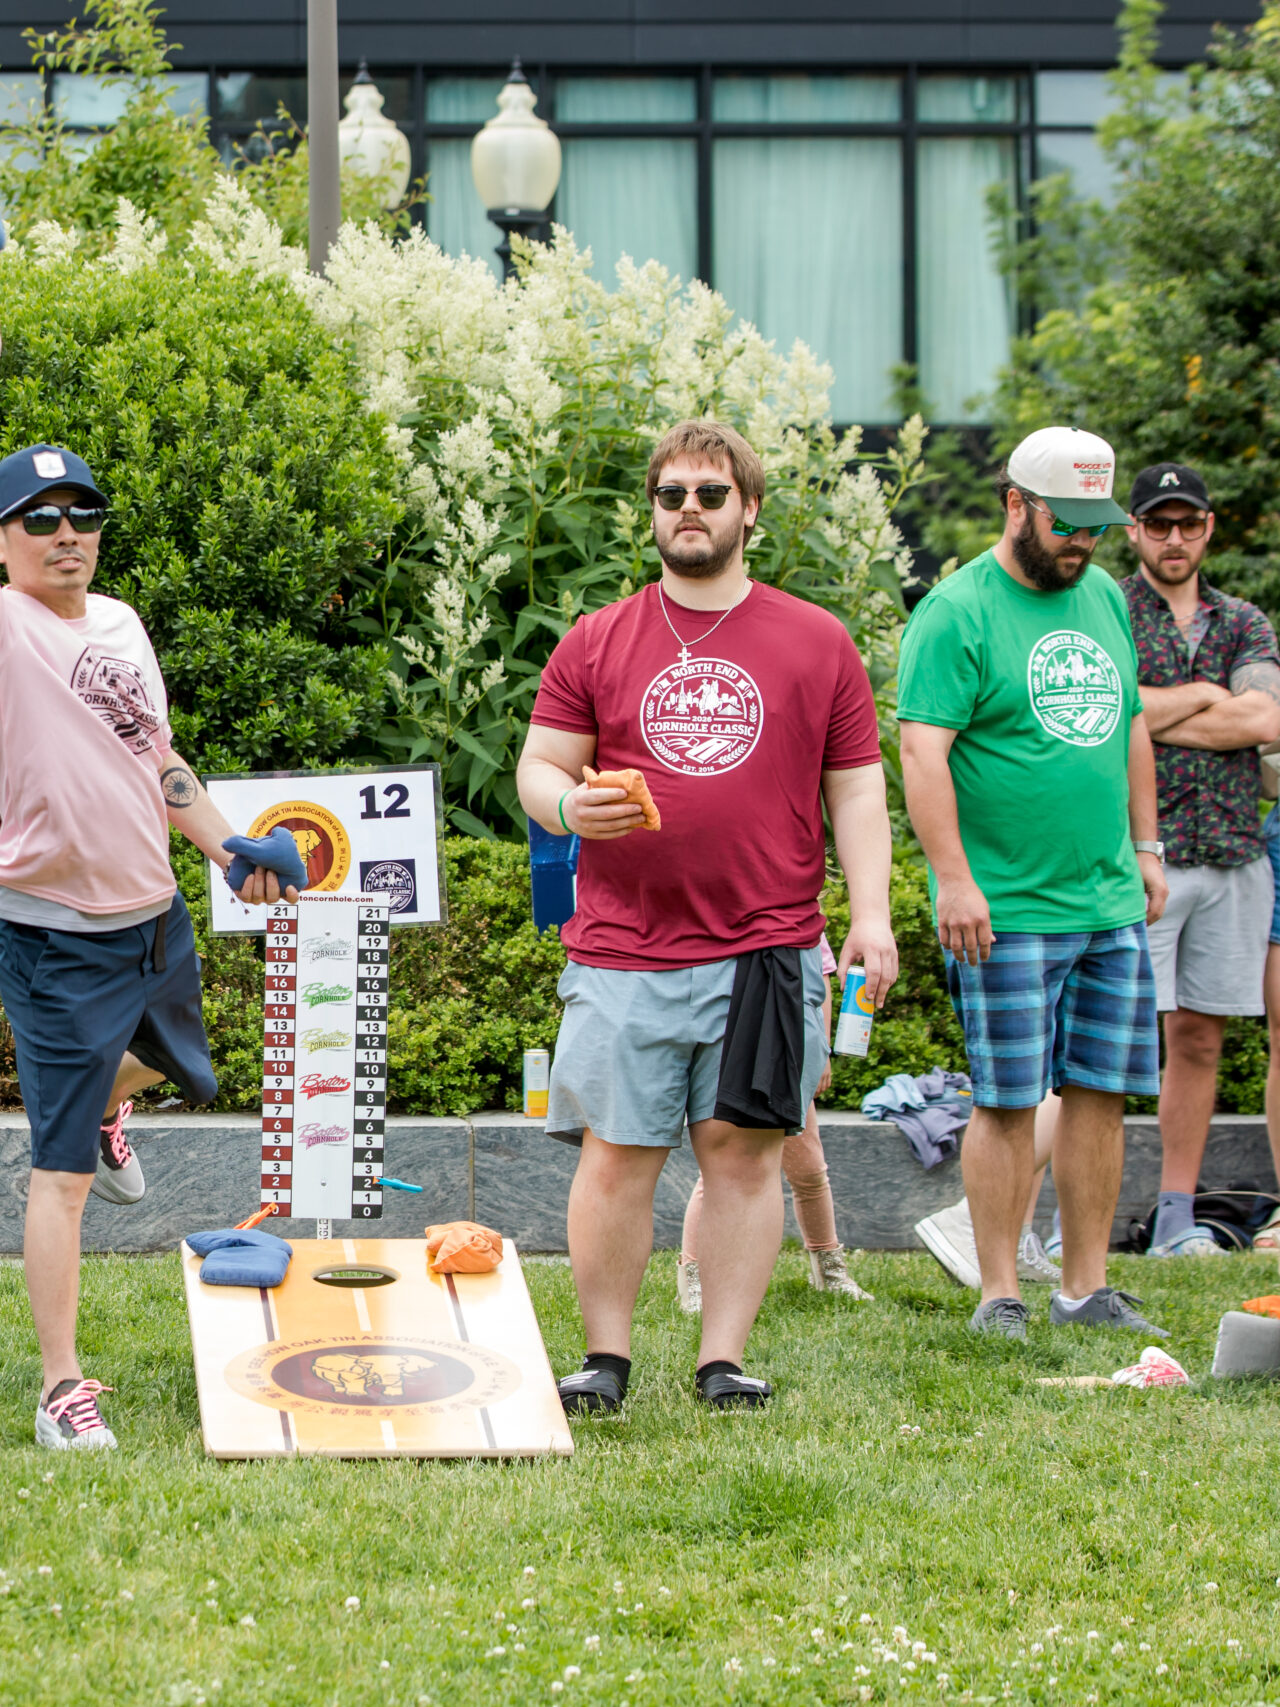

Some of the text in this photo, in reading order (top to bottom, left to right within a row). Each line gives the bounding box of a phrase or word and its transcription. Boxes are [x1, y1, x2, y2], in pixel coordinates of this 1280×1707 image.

[1040, 634, 1095, 653] NORTH END
[670, 663, 739, 680] NORTH END
[1035, 693, 1118, 707] CORNHOLE CLASSIC
[127, 706, 158, 727] CLASSIC
[646, 721, 755, 737] CORNHOLE CLASSIC
[682, 764, 715, 773] EST. 2016
[358, 783, 411, 820] 12
[256, 820, 268, 834] HOW
[267, 811, 280, 820] OAK
[281, 806, 292, 814] TIN
[292, 806, 334, 825] ASSOCIATION
[299, 895, 374, 904] toncornhole.com
[273, 906, 288, 916] 21
[365, 908, 380, 918] 21
[273, 921, 288, 931] 20
[365, 923, 381, 933] 20
[274, 935, 289, 945] 19
[366, 937, 381, 947] 19
[273, 949, 288, 959] 18
[312, 950, 347, 960] CORNHOLE
[365, 951, 380, 961] 18
[273, 964, 288, 974] 17
[365, 966, 380, 975] 17
[272, 978, 287, 987] 16
[364, 979, 379, 989] 16
[273, 992, 288, 1002] 15
[365, 994, 380, 1004] 15
[272, 1006, 287, 1016] 14
[364, 1008, 379, 1018] 14
[273, 1020, 287, 1030] 13
[364, 1022, 379, 1032] 13
[272, 1034, 287, 1044] 12
[364, 1036, 379, 1046] 12
[310, 1041, 345, 1052] CORNHOLE
[272, 1049, 285, 1059] 11
[364, 1051, 377, 1061] 11
[271, 1062, 287, 1072] 10
[363, 1064, 379, 1074] 10
[275, 1077, 282, 1087] 9
[298, 1073, 349, 1089] Boston
[366, 1079, 374, 1089] 9
[274, 1091, 282, 1101] 8
[366, 1093, 374, 1103] 8
[274, 1106, 282, 1115] 7
[366, 1107, 374, 1117] 7
[273, 1120, 281, 1130] 6
[297, 1122, 347, 1138] Boston
[365, 1122, 373, 1132] 6
[273, 1134, 281, 1144] 5
[365, 1136, 373, 1146] 5
[273, 1148, 281, 1158] 4
[364, 1150, 373, 1160] 4
[273, 1162, 280, 1172] 3
[365, 1164, 372, 1174] 3
[272, 1176, 279, 1186] 2
[363, 1178, 371, 1188] 2
[273, 1191, 278, 1200] 1
[365, 1193, 370, 1202] 1
[362, 1206, 371, 1216] 0
[291, 1338, 326, 1347] OAK
